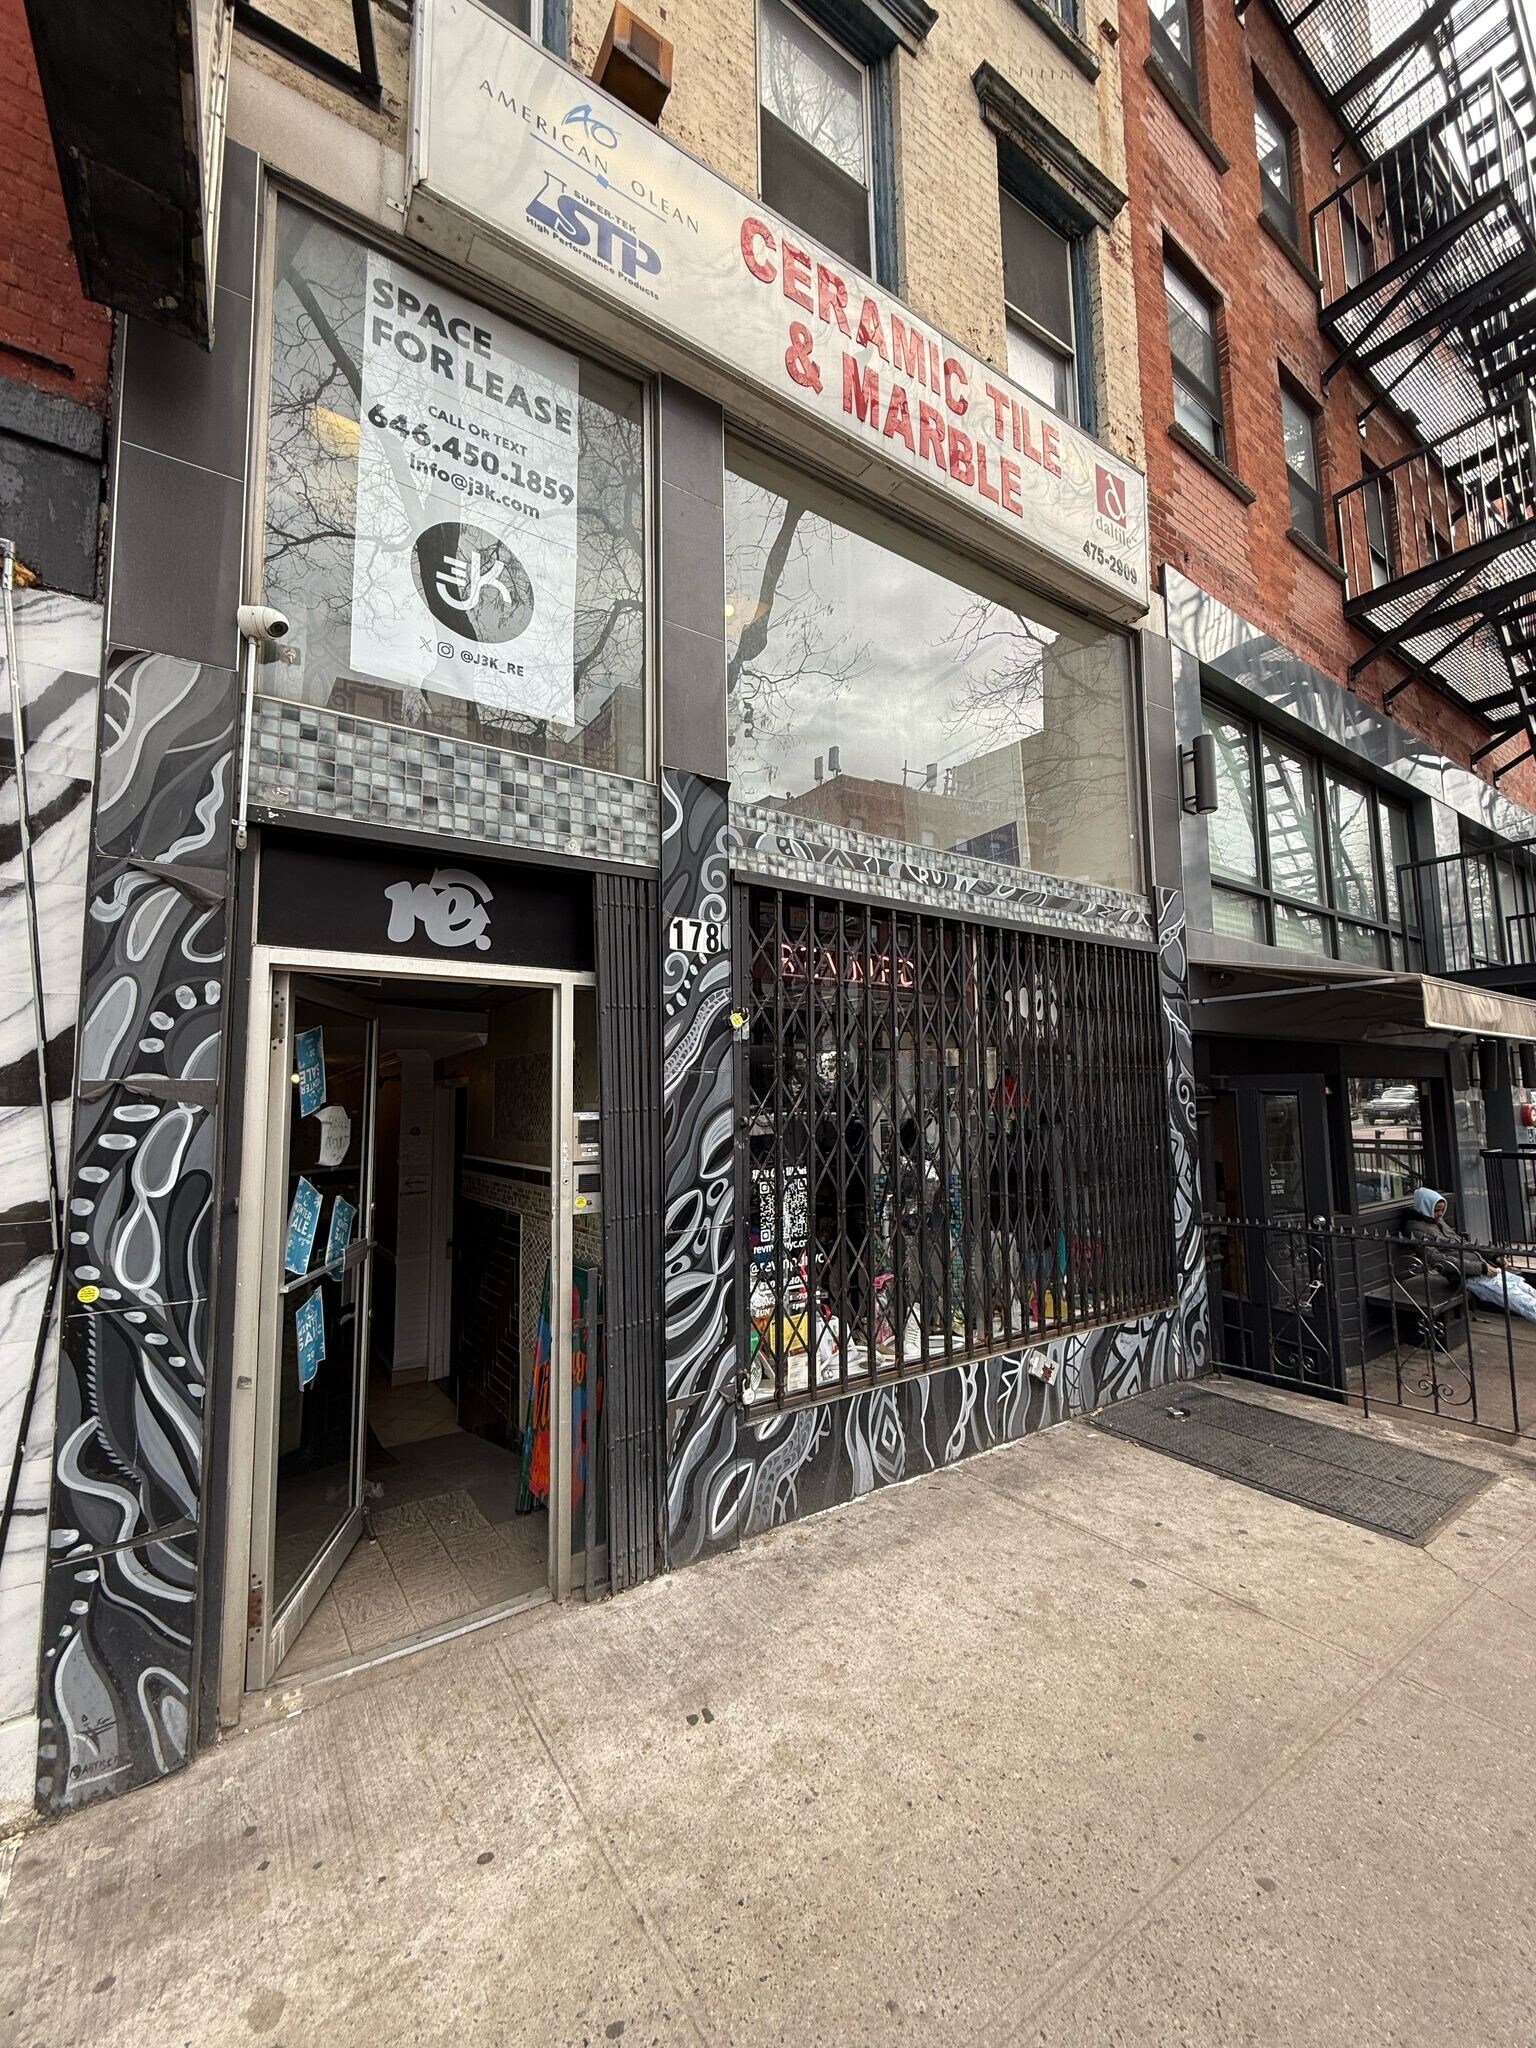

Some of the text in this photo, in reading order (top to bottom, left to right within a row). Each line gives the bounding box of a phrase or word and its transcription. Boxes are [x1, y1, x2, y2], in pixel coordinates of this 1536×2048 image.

[479, 79, 700, 234] AMERICAN OLEAN
[574, 190, 637, 234] SUPER-TEK
[526, 216, 660, 301] High Performance Products
[372, 277, 492, 360] SPACE
[740, 216, 1062, 479] CERAMIC TILE
[371, 316, 572, 436] FOR LEASE
[367, 403, 576, 508] 646.450.1859
[427, 405, 528, 458] CALL OR TEXT
[784, 321, 1024, 518] & MARBLE
[410, 453, 541, 520] info@j3k.com
[1083, 540, 1138, 585] 475-2909
[461, 651, 524, 677] @J3K_RE
[673, 920, 719, 953] 178
